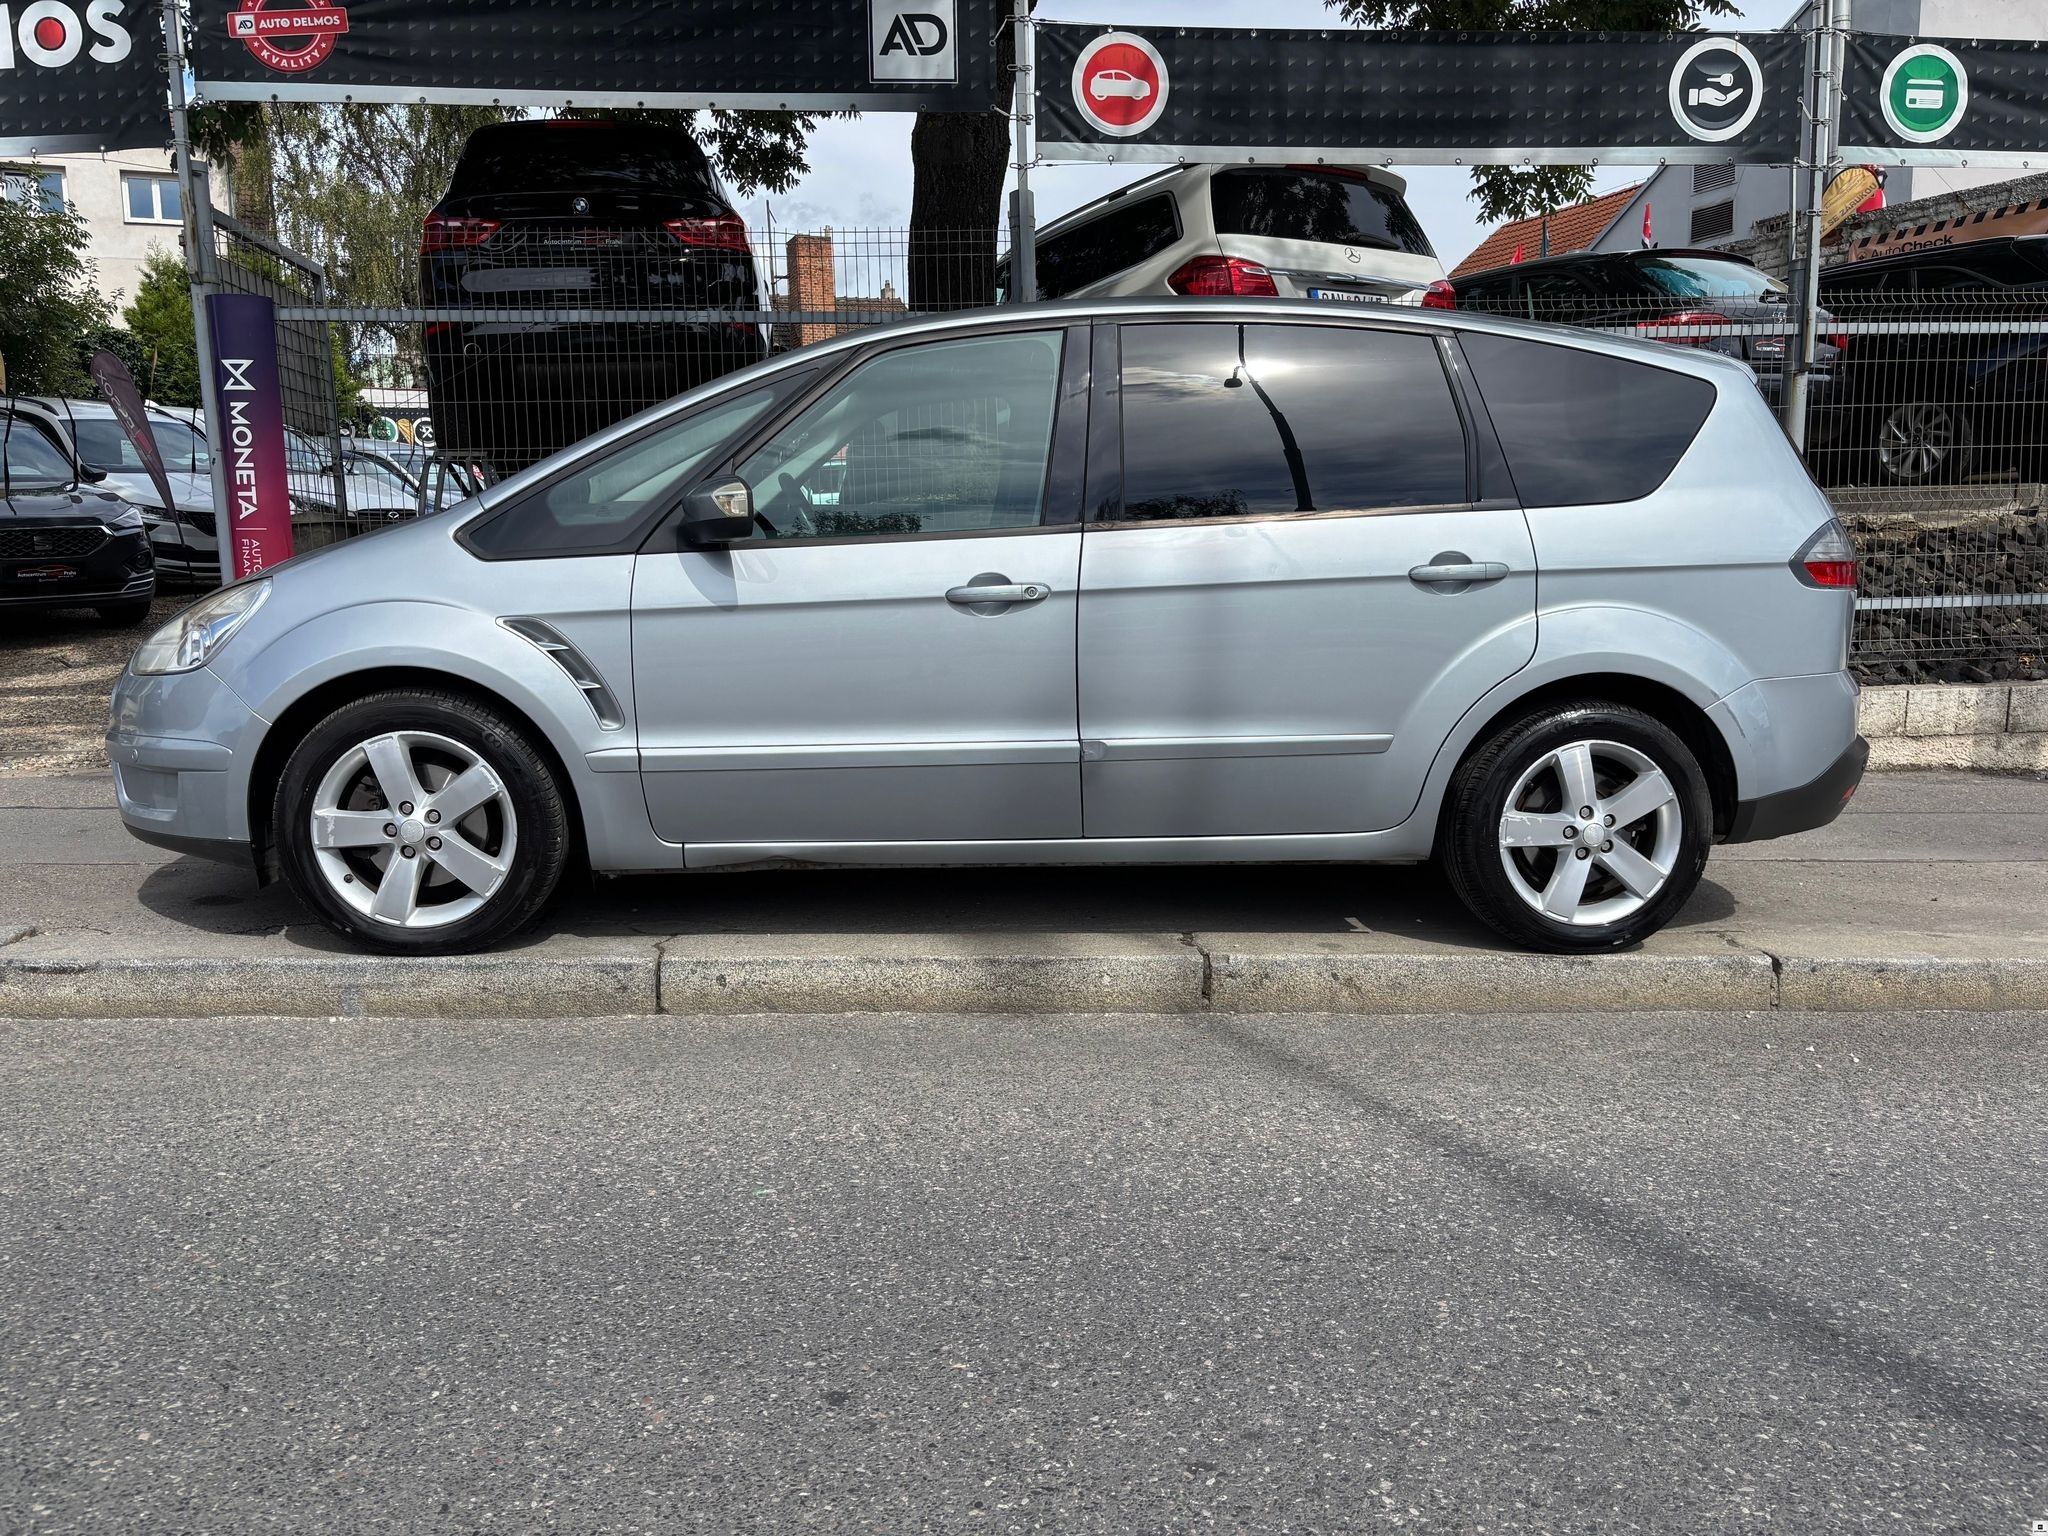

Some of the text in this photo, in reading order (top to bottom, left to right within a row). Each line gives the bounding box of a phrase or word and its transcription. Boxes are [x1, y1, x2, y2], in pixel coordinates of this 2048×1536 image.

[0, 0, 132, 69] OS
[259, 18, 291, 29] AUTO
[293, 15, 341, 27] DELMOS
[879, 13, 948, 56] AD
[260, 48, 321, 68] KVALITY
[229, 401, 259, 520] MONETA
